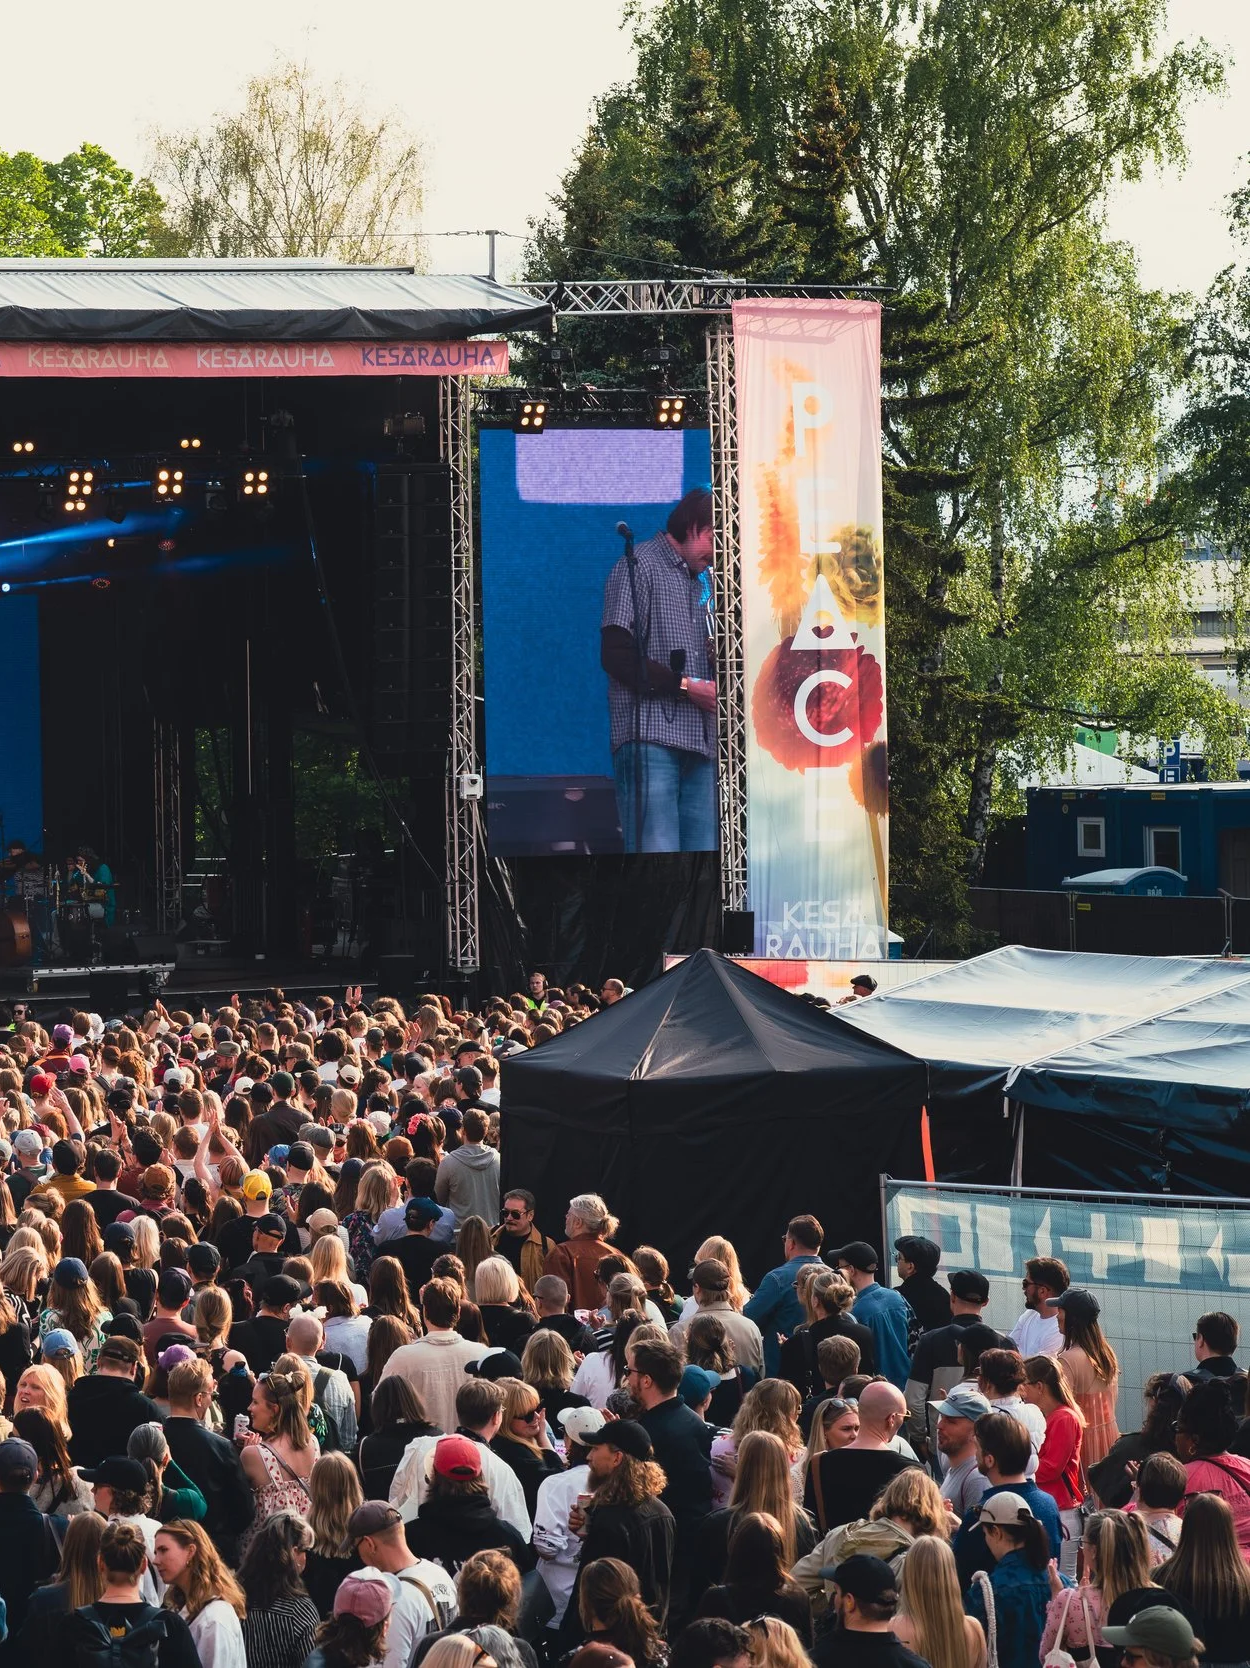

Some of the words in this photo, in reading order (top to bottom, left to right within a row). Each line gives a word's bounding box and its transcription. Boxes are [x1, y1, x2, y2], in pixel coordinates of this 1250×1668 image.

[27, 347, 169, 368] KESÄRAUHA
[197, 347, 335, 368] KESÄRAUHA
[361, 347, 496, 367] KESÄRAUHA
[790, 383, 857, 843] PEACE
[783, 900, 867, 930] KESÄ
[766, 932, 883, 959] RAUHA
